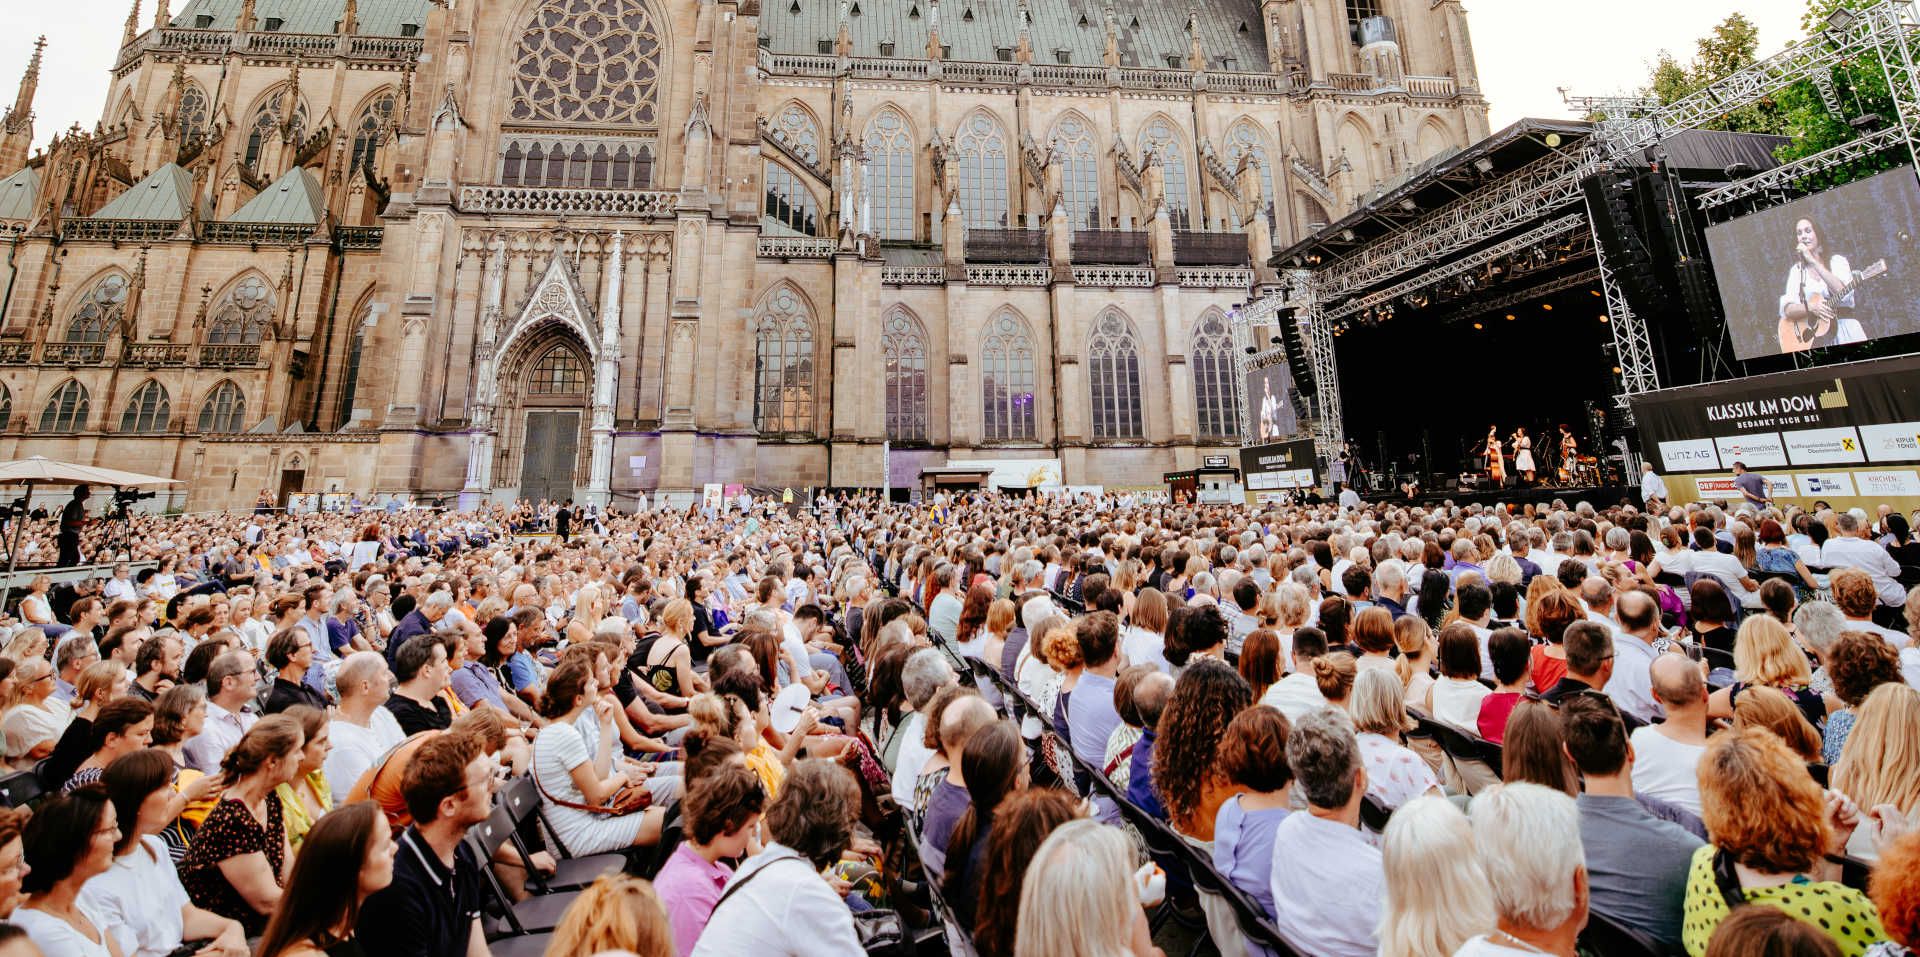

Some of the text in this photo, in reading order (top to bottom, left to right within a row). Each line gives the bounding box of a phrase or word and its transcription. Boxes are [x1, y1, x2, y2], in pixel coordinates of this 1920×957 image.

[1707, 394, 1816, 421] KLASSIK AM DOM
[1737, 414, 1820, 429] BEDANKT SICH BEI
[1694, 450, 1710, 459] AG
